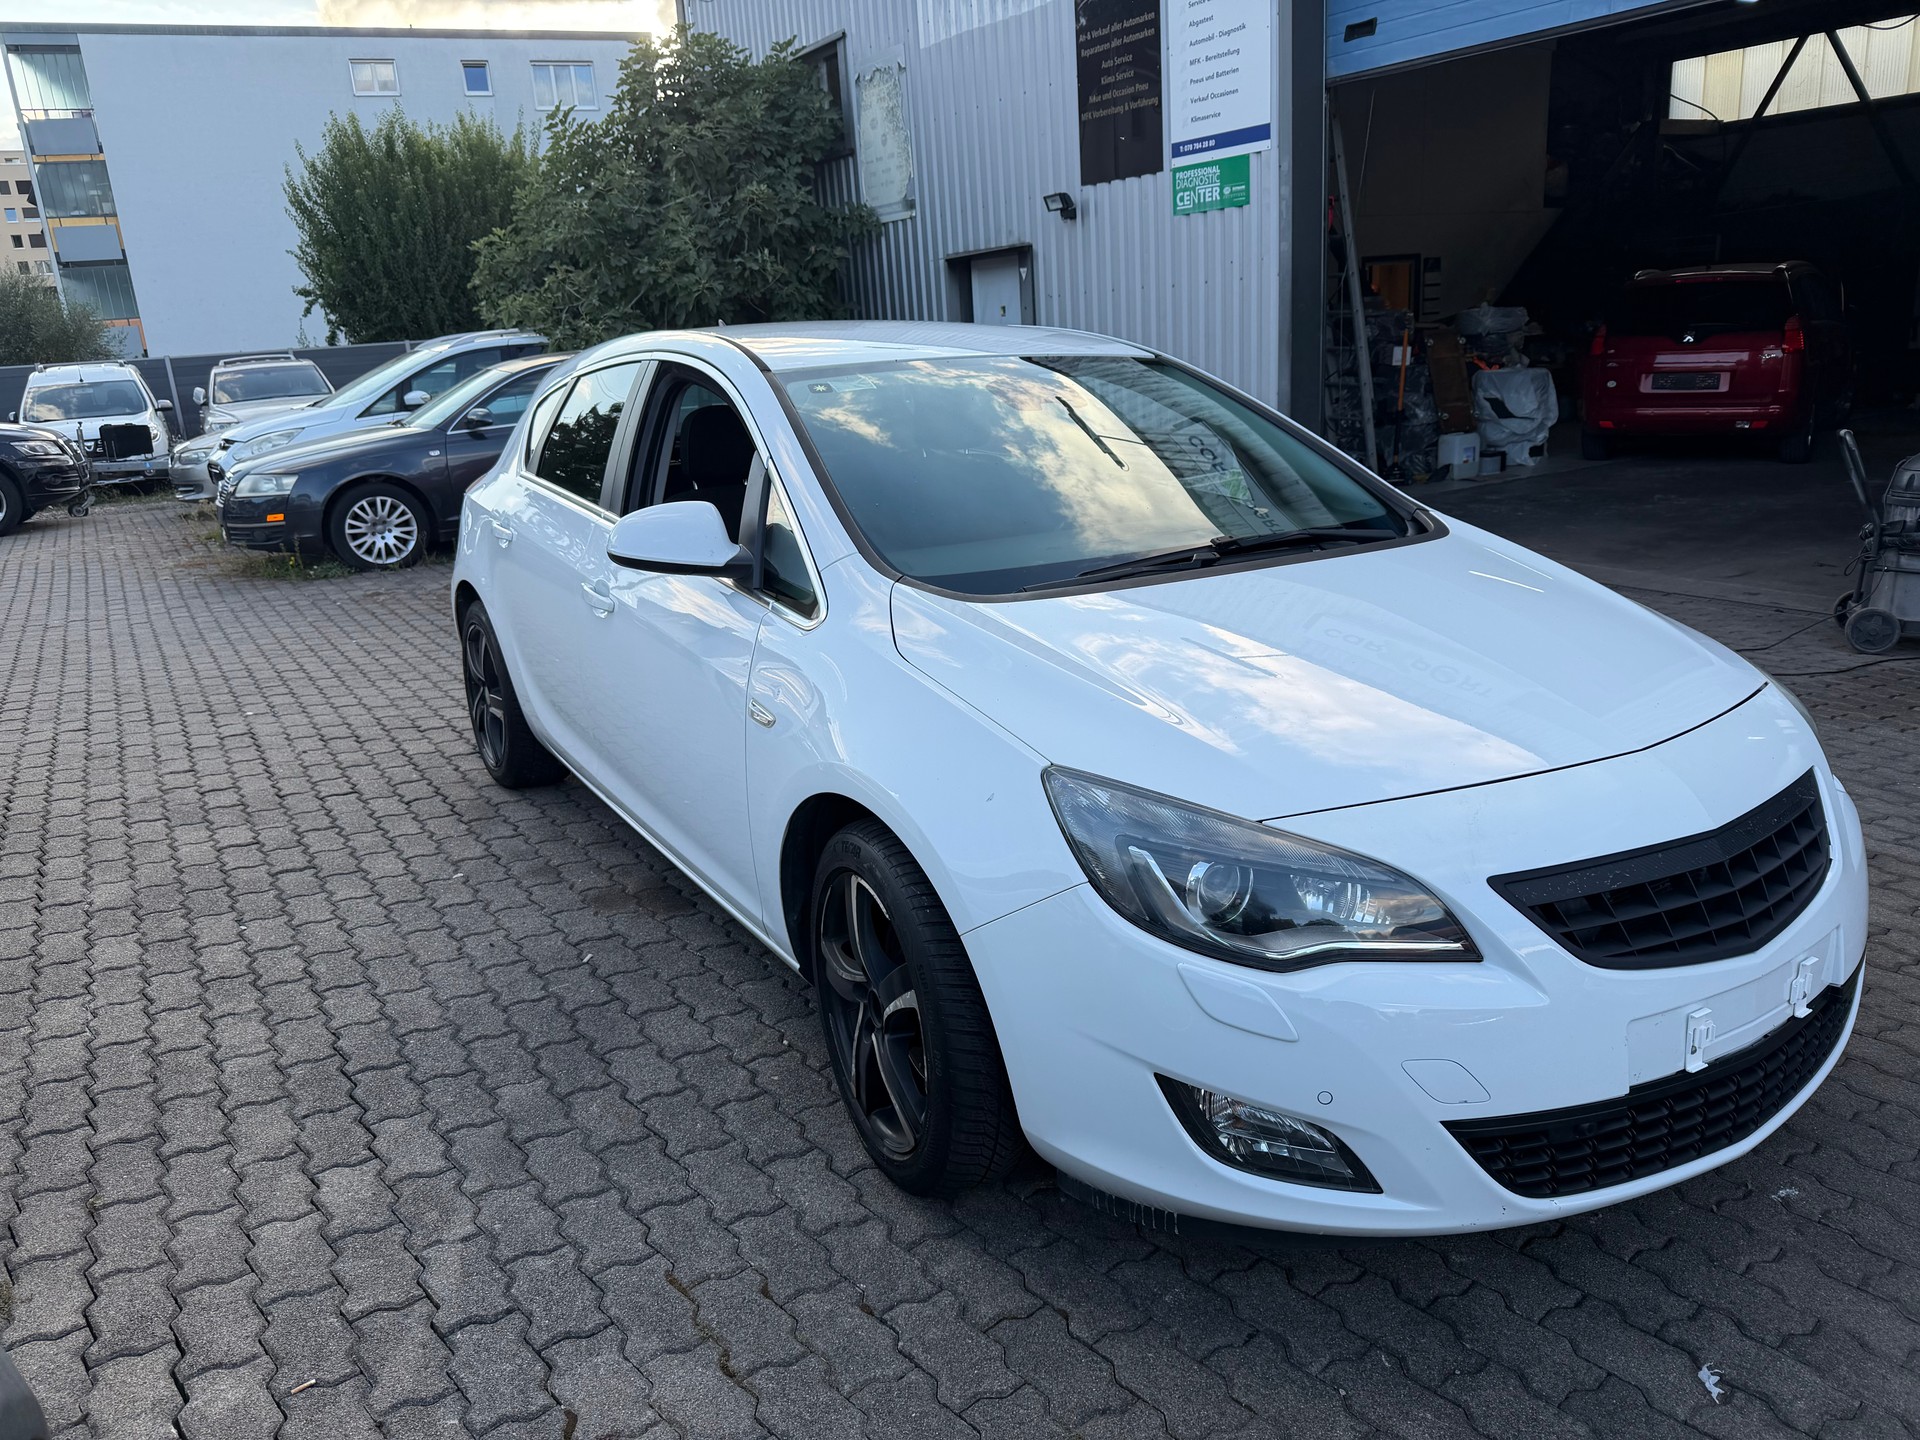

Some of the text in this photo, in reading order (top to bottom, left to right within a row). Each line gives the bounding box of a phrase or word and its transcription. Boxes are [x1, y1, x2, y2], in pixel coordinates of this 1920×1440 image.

[1091, 24, 1110, 39] Verkauf
[1111, 21, 1122, 33] aller
[1123, 11, 1155, 29] Automarken
[1189, 14, 1214, 28] Abgastest
[1081, 27, 1155, 58] Reparaturen aller Automarken
[1189, 32, 1215, 47] Automobil
[1218, 22, 1246, 38] Diagnostik
[1101, 53, 1133, 69] Auto Service
[1189, 57, 1202, 66] MFK
[1205, 47, 1240, 62] Bereitstellung
[1101, 69, 1135, 85] Klima Service
[1190, 66, 1240, 86] Pneus und Batterien
[1102, 89, 1112, 101] und
[1112, 86, 1135, 98] Occasion
[1190, 88, 1239, 104] Verkauf Occasionen
[1191, 111, 1221, 123] Klimaservice
[1175, 164, 1220, 180] PROFESSIONAL
[1176, 172, 1220, 190] DIAGNOSTIC
[1176, 184, 1220, 208] CENTER
